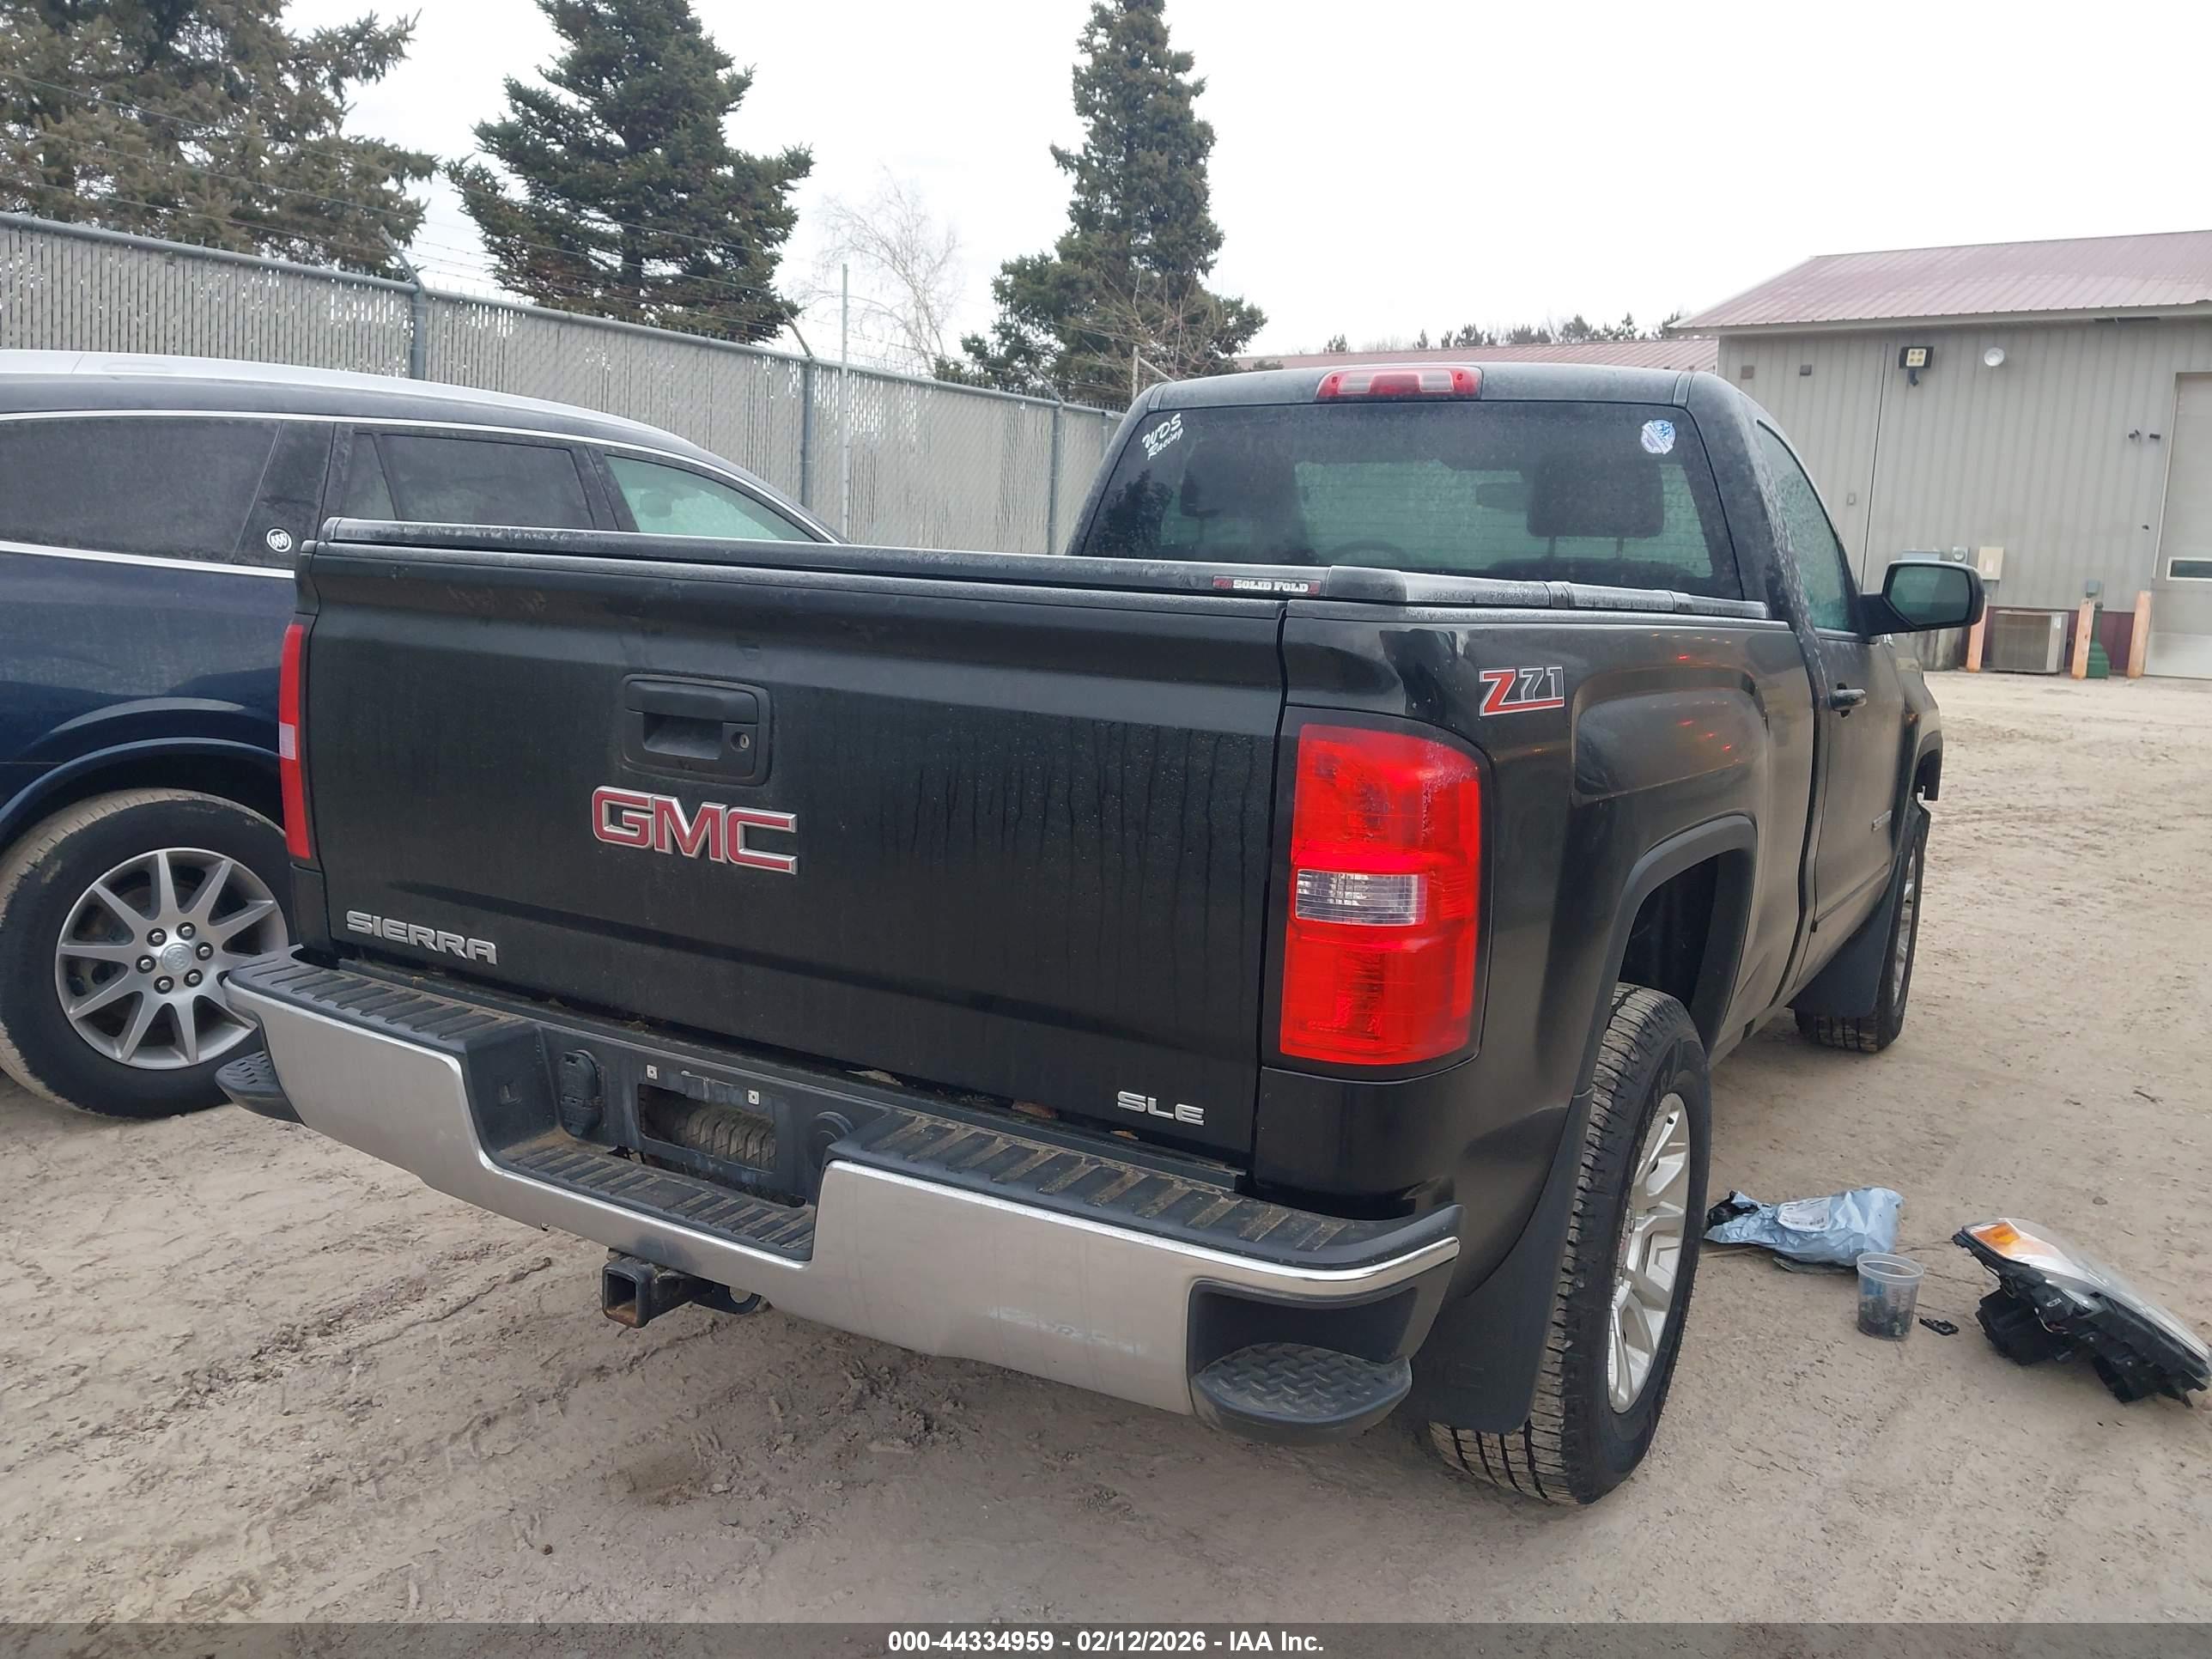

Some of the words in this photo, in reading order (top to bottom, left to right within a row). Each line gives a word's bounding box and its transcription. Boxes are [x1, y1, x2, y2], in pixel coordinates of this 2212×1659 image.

[1141, 412, 1182, 448] WDS
[1146, 427, 1184, 461] Racing
[1232, 579, 1272, 590] SOLID
[1273, 580, 1309, 592] FOLD
[1479, 665, 1565, 718] Z71
[591, 784, 799, 875] GMC
[345, 909, 499, 965] SIERRA
[1117, 1091, 1205, 1127] SLE
